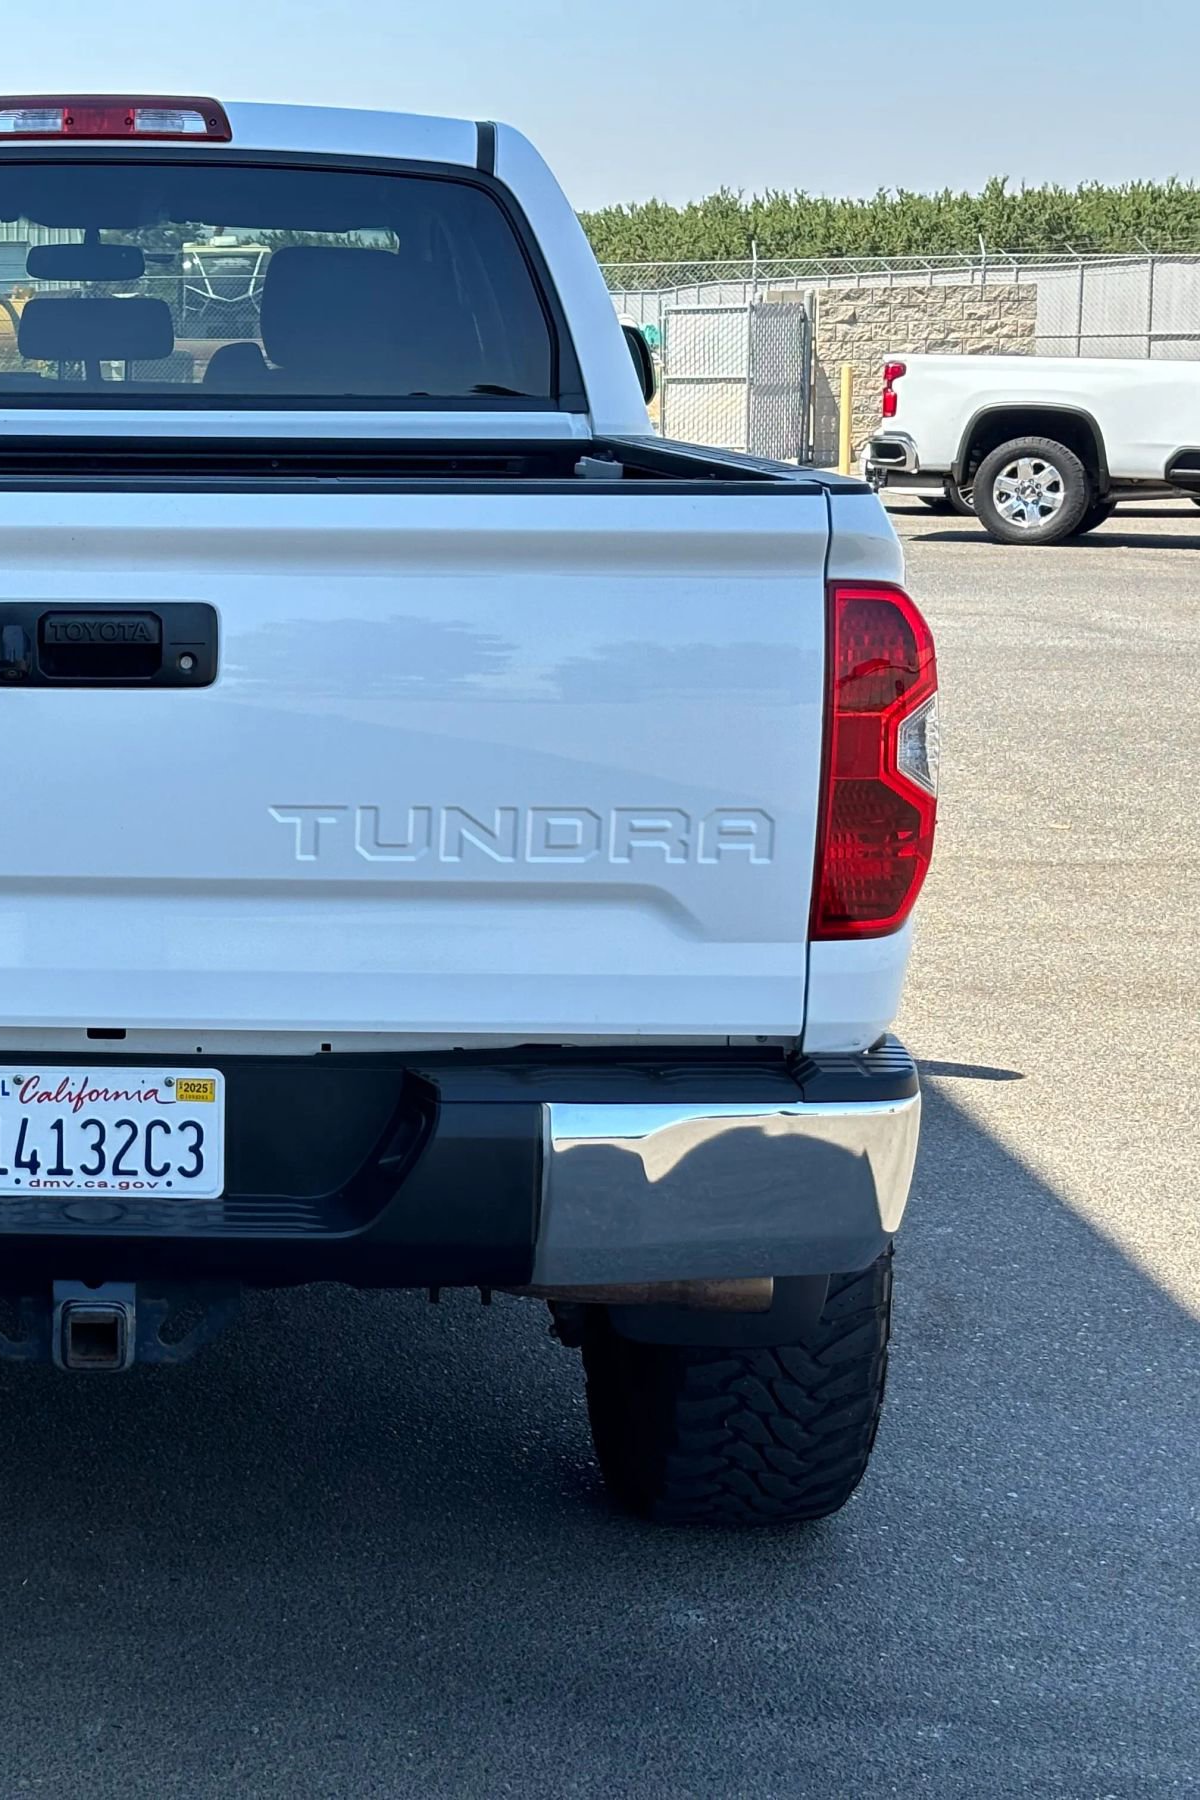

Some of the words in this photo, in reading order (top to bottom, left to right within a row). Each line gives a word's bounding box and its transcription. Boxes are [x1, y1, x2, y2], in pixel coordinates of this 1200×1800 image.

[51, 622, 151, 642] TOYOTA
[267, 805, 776, 864] TUNDRA
[18, 1075, 177, 1113] California
[183, 1082, 209, 1094] 2025
[28, 1177, 160, 1189] dmv.ca.gov
